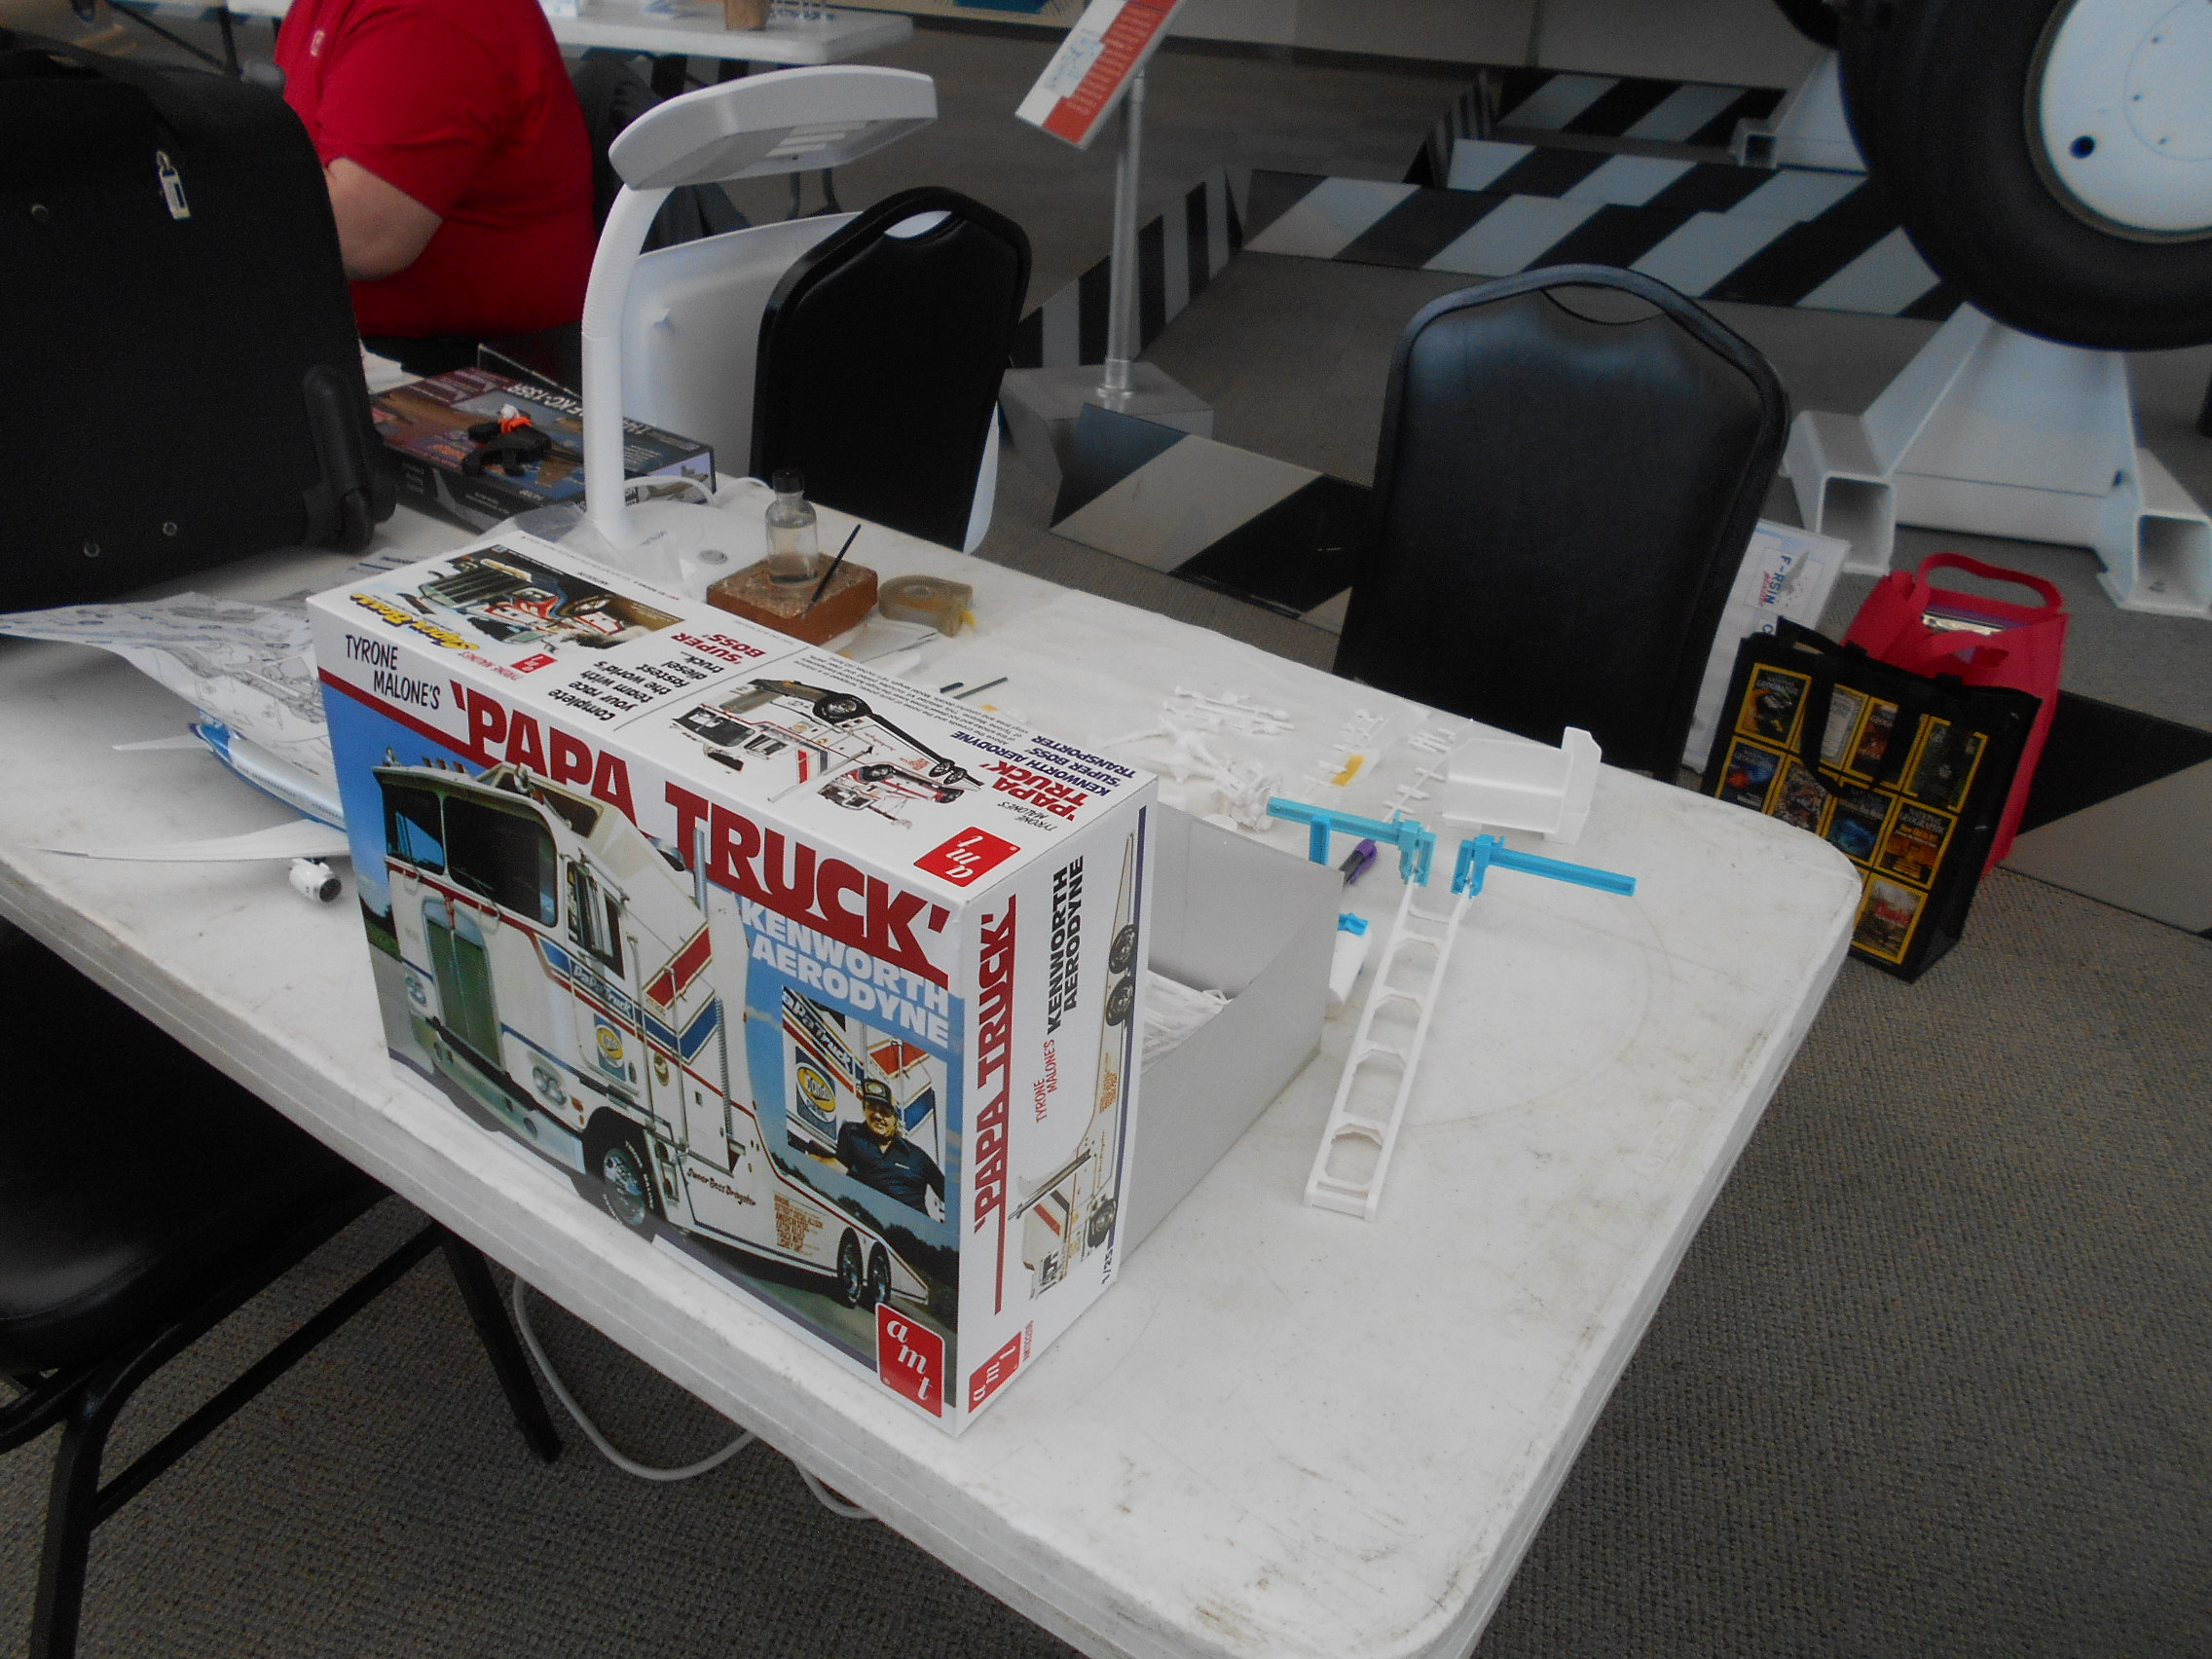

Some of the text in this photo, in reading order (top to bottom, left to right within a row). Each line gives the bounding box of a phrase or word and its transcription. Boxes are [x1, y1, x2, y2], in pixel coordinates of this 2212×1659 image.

[1766, 555, 1791, 604] F-RSIN
[345, 633, 399, 671] TYRONE
[661, 661, 707, 680] diesel
[373, 672, 441, 711] MALONE'S
[569, 682, 638, 711] your race
[580, 670, 653, 703] team with
[594, 661, 672, 695] the world's
[636, 664, 689, 687] fastest
[548, 689, 615, 720] Complete
[950, 731, 1110, 795] KENWORTH AERODYNE
[1032, 736, 1135, 778] TRANSPORTER
[980, 760, 1088, 806] TRUCK'
[992, 777, 1077, 820] 'PAPA
[449, 678, 951, 990] 'PAPA TRUCK'
[1014, 815, 1056, 831] TYRONE
[739, 894, 949, 1020] KENWORTH
[1048, 865, 1068, 1035] KENWORTH
[1062, 855, 1084, 1013] AERODYNE
[752, 934, 949, 1050] AERODYNE
[977, 894, 1016, 1089] TRUCK'
[1046, 1039, 1058, 1093] MALONE'S
[1033, 1077, 1047, 1124] TYRONE
[886, 1318, 930, 1402] amt
